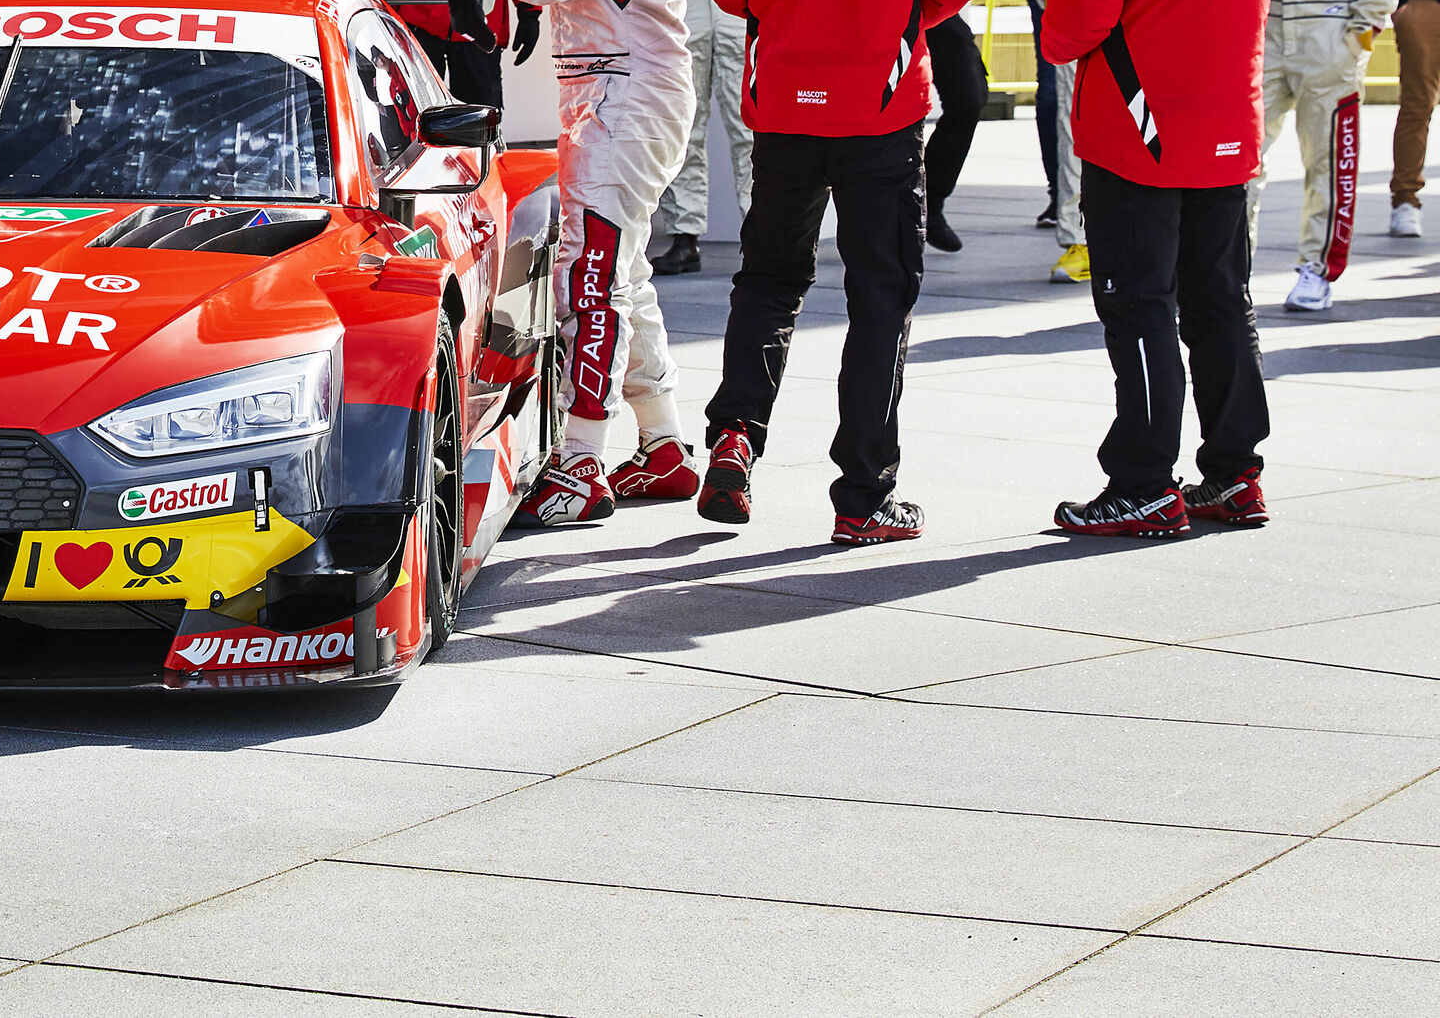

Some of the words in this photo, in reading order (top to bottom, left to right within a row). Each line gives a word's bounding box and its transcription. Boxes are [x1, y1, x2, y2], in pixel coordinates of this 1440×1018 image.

[1339, 116, 1356, 171] Sport
[1338, 175, 1354, 218] Audi
[148, 478, 229, 513] Castrol
